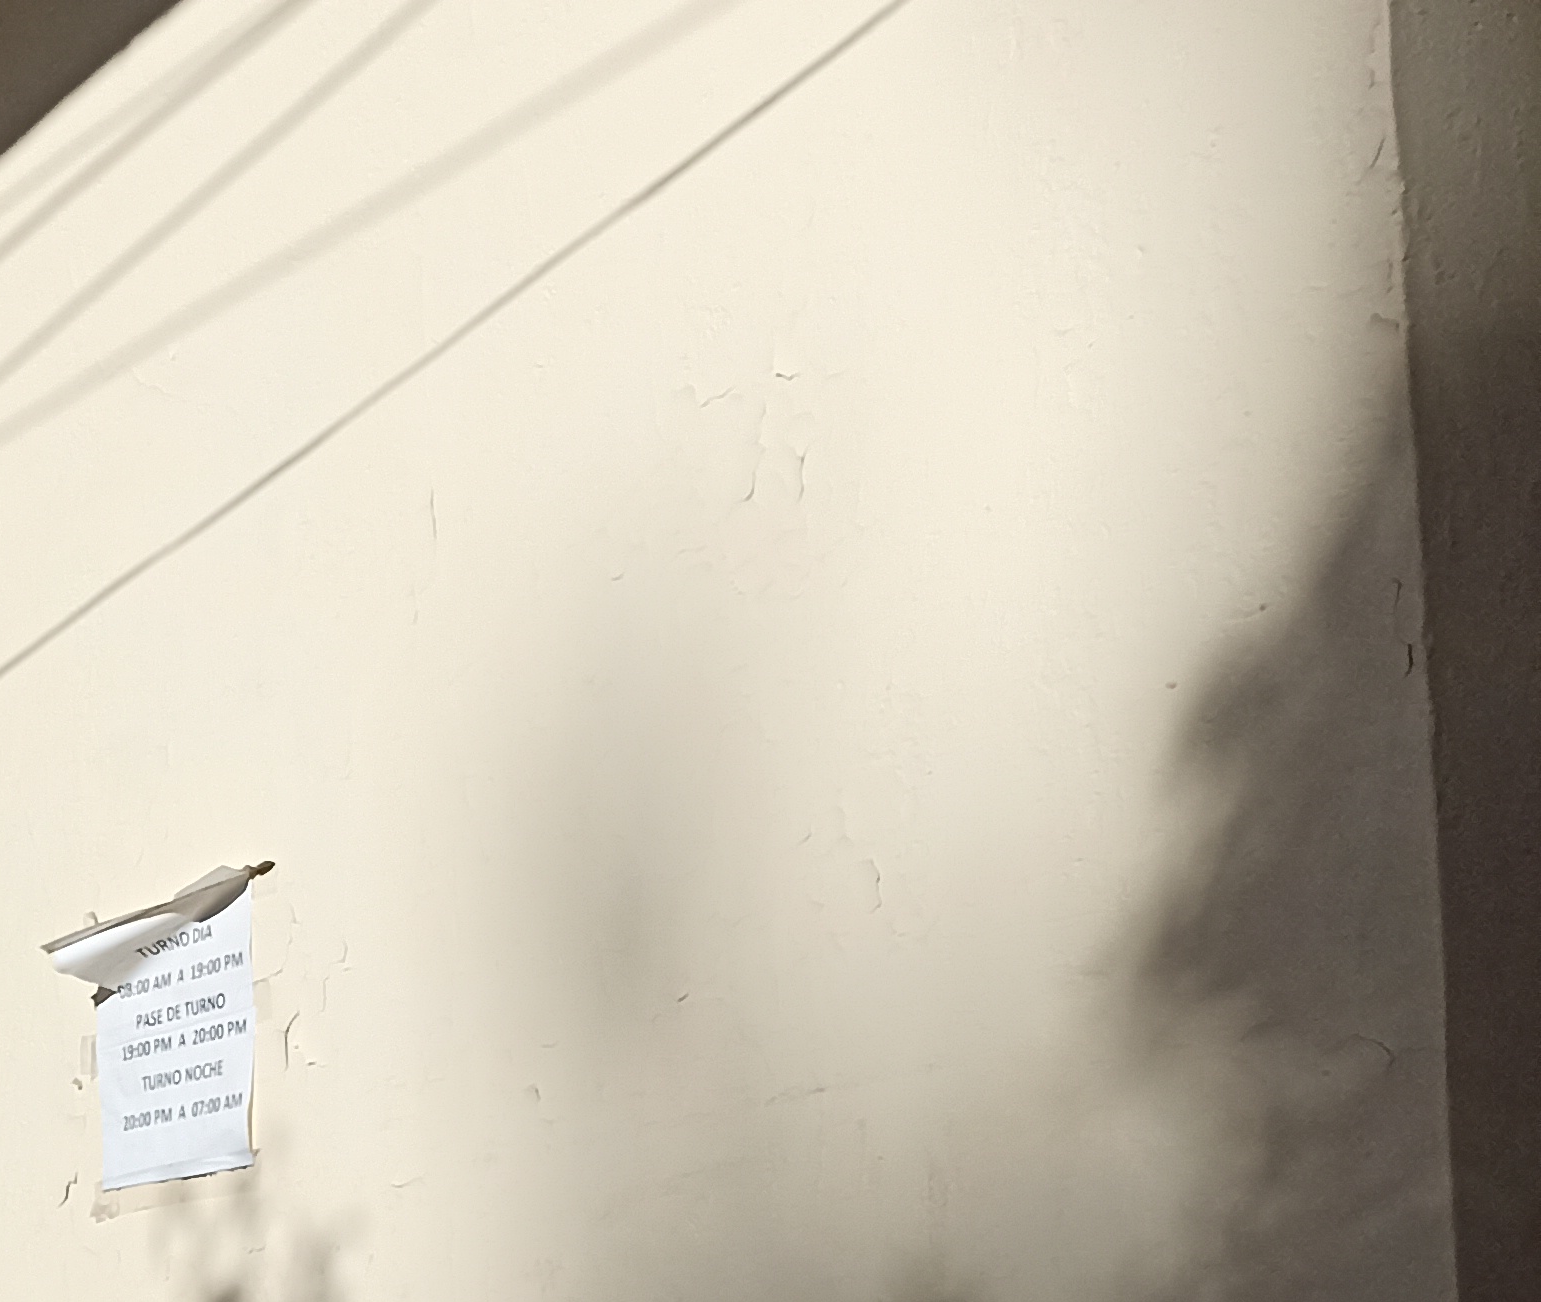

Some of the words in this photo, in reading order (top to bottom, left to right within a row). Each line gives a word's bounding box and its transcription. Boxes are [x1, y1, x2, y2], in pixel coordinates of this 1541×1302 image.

[135, 930, 190, 960] TURNO
[193, 924, 213, 944] DIA
[152, 972, 172, 991] AM
[176, 969, 185, 983] A
[190, 957, 222, 981] 19:00
[224, 951, 244, 971] PM
[135, 1005, 164, 1030] PASE
[166, 1003, 182, 1022] DE
[185, 992, 226, 1020] TURNO
[121, 1038, 151, 1062] 19:00
[153, 1035, 173, 1054] PM
[178, 1032, 187, 1047] A
[192, 1024, 224, 1045] 20:00
[227, 1018, 247, 1035] PM
[141, 1068, 181, 1092] TURNO
[185, 1060, 225, 1083] NOCHE
[123, 1108, 151, 1132] 20:00
[153, 1106, 173, 1124] PM
[177, 1104, 186, 1121] A
[191, 1097, 221, 1118] 07:00
[223, 1092, 243, 1109] AM
